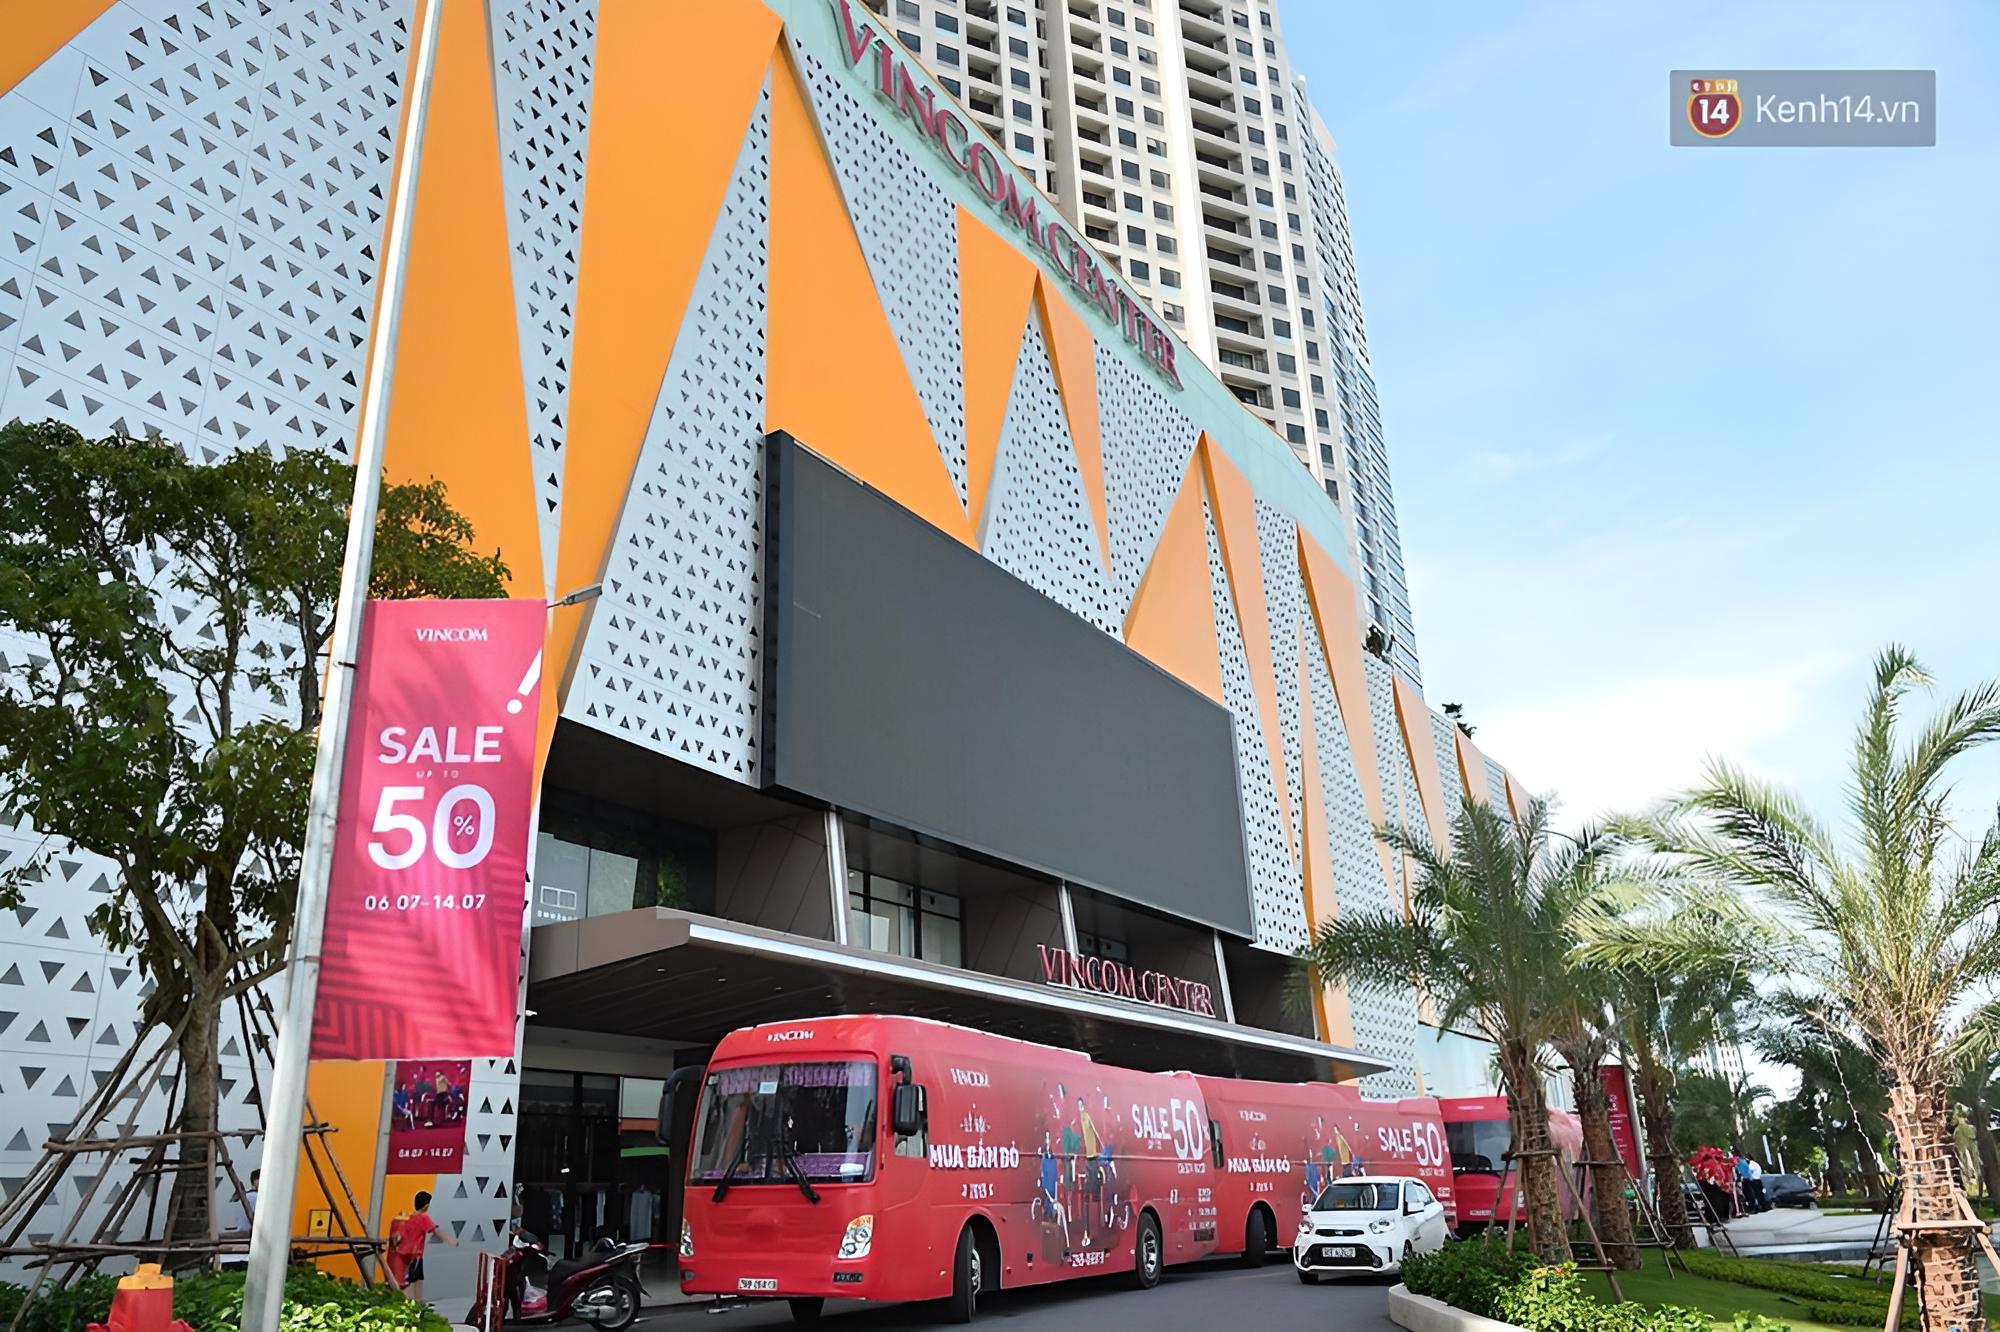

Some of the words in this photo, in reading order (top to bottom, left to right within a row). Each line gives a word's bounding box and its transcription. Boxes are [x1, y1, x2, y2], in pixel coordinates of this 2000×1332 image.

[835, 0, 1046, 249] VINCOM
[1046, 222, 1184, 392] CENTER
[415, 628, 489, 642] VINCOM
[377, 726, 504, 764] SALE
[1037, 944, 1139, 1001] VINCOM
[1141, 970, 1216, 1018] CENTER
[1131, 1103, 1172, 1140] SALE
[1378, 1127, 1413, 1152] SALE
